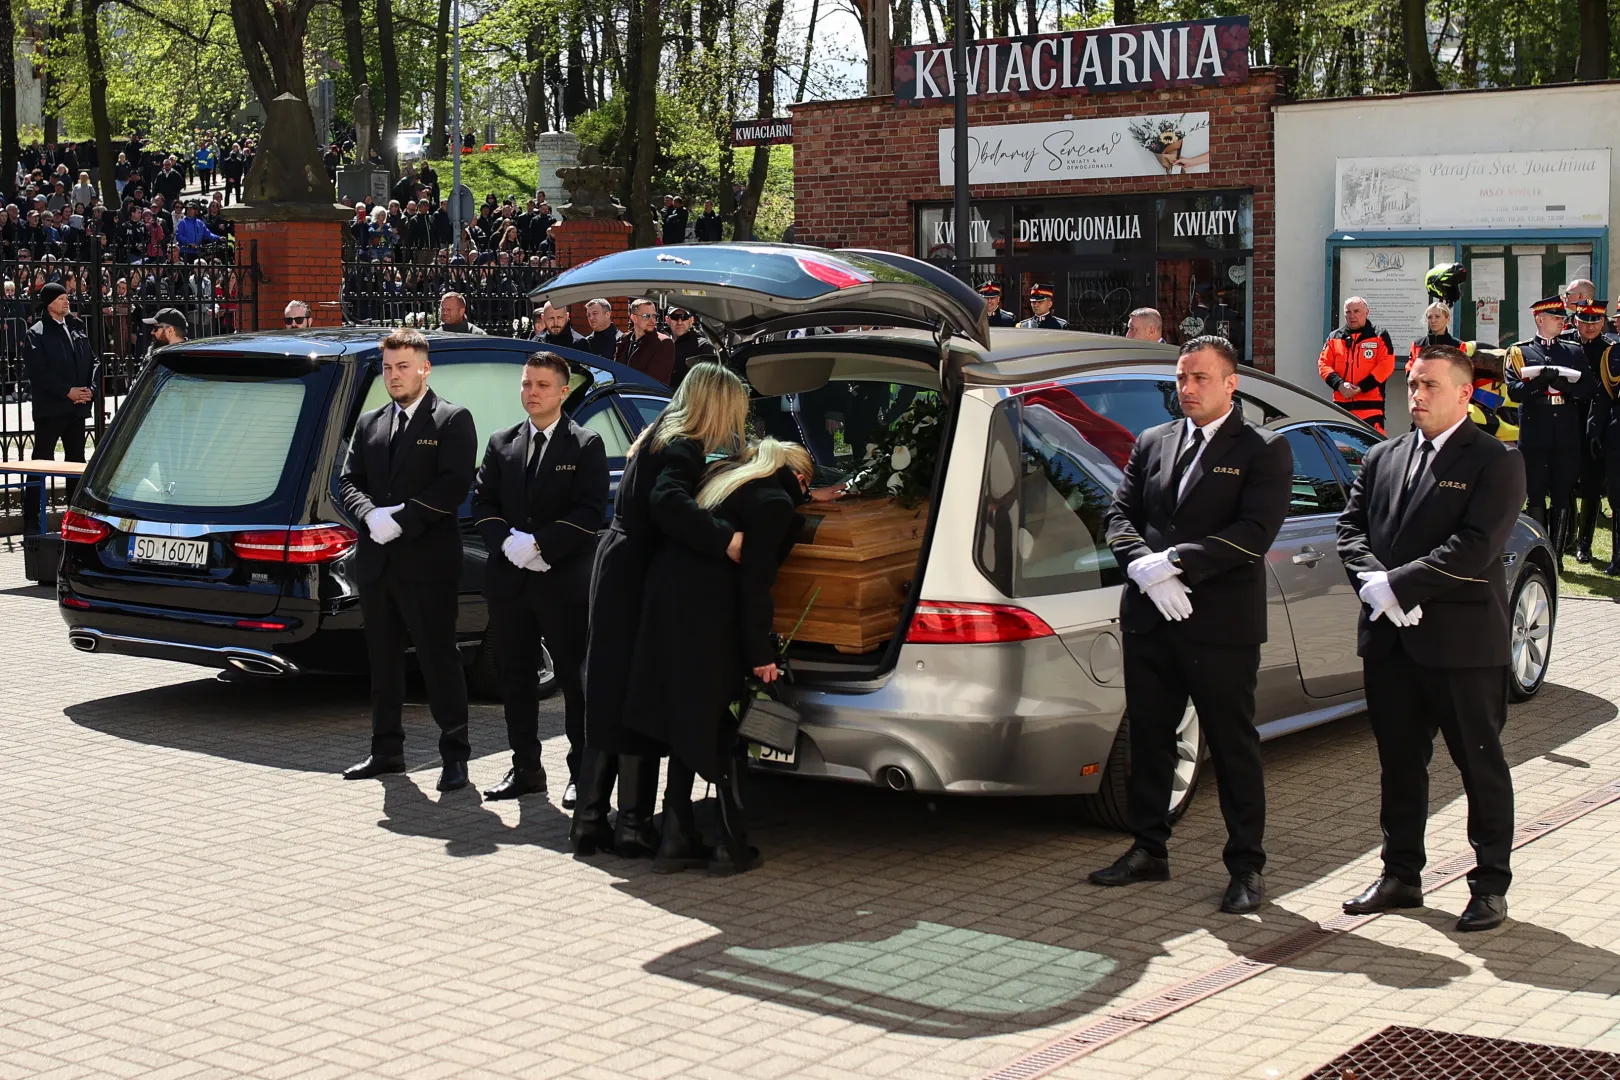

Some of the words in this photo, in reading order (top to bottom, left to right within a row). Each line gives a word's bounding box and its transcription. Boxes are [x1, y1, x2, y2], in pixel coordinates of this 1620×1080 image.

[914, 24, 1225, 99] KWIACIARNIA
[735, 123, 793, 141] KWIACIARNI
[951, 136, 1039, 173] Obdaruj
[1042, 129, 1121, 171] Sercem
[1429, 160, 1485, 181] Parafia
[934, 220, 991, 244] KWTY
[1019, 214, 1141, 243] DEWOCJONALIA
[1173, 210, 1237, 236] KWIATY
[1213, 466, 1240, 475] OAZA
[1439, 480, 1467, 490] OAZA
[137, 539, 155, 559] SD
[161, 541, 205, 564] 1607M
